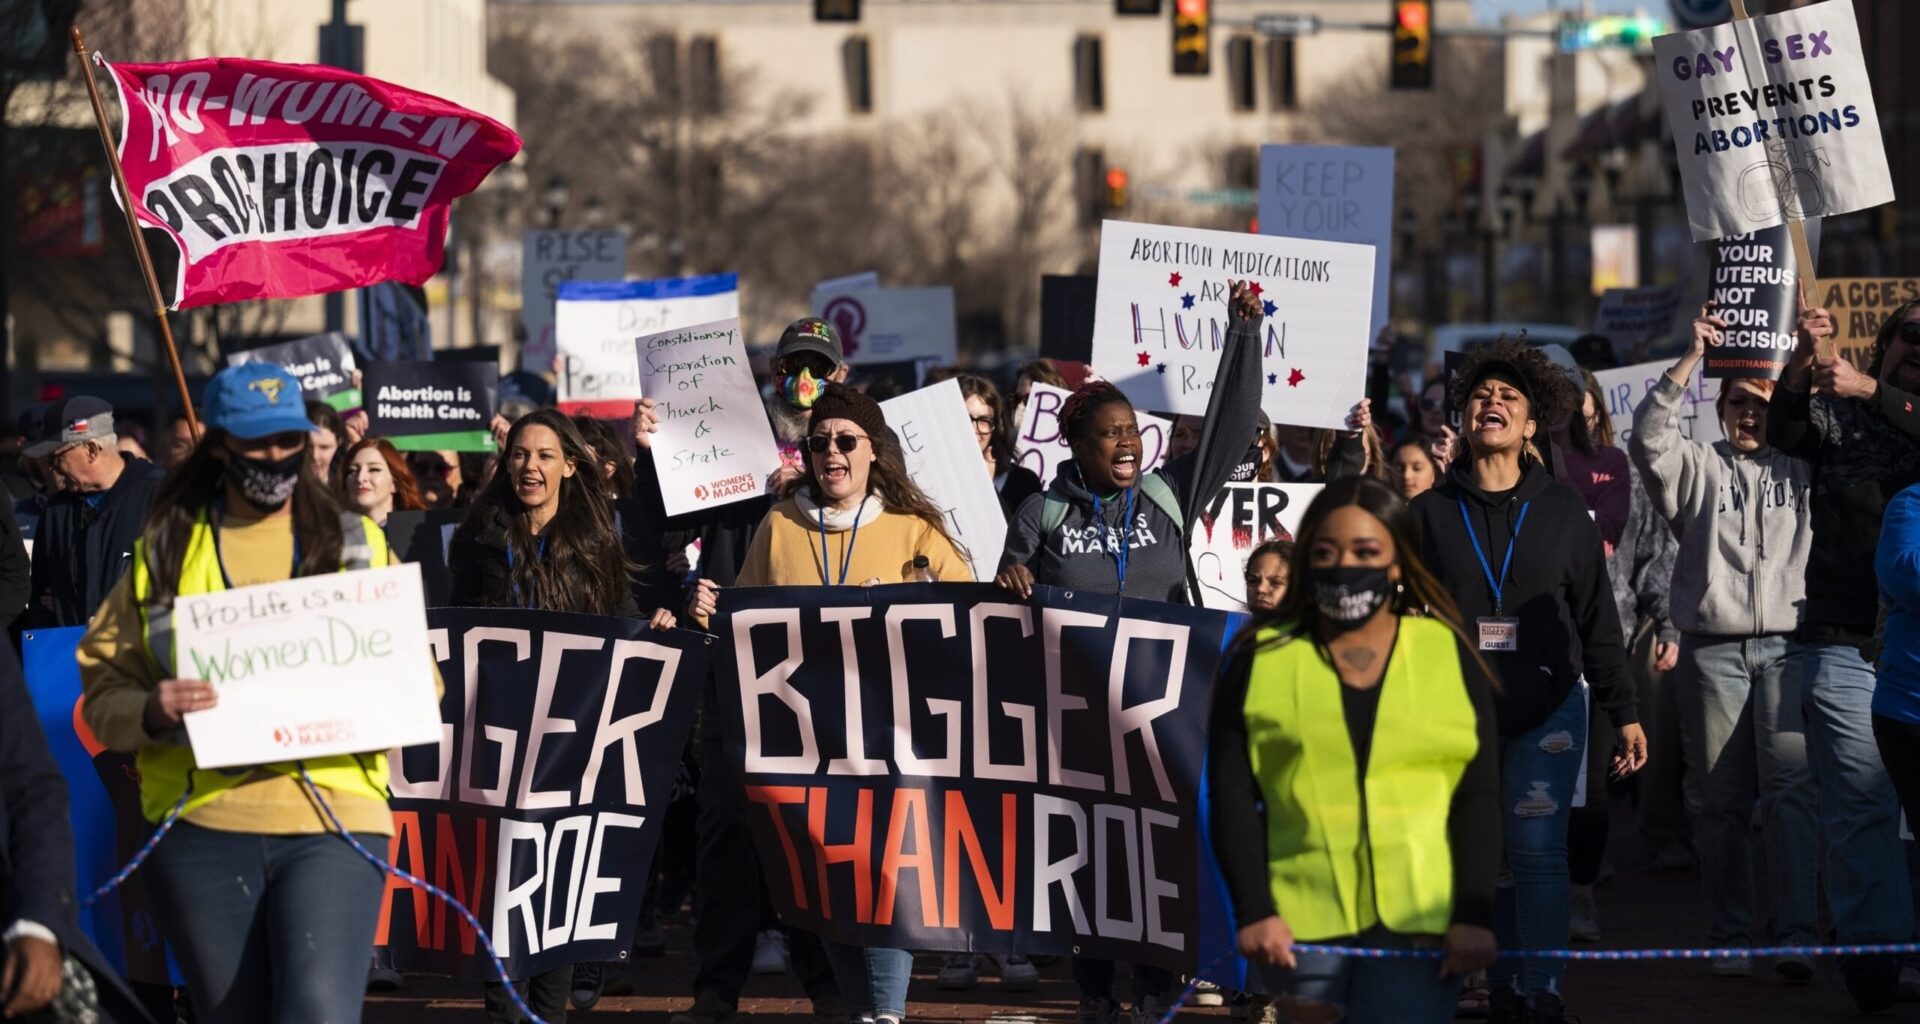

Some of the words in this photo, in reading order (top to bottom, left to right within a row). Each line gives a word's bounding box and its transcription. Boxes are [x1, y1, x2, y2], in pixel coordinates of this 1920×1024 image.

[1673, 46, 1735, 81] GAY
[1764, 30, 1832, 64] SEX
[1692, 75, 1836, 120] PREVENTS
[136, 71, 482, 162] RO-WOMEN
[1694, 105, 1861, 155] ABORTIONS
[1276, 161, 1364, 196] KEEP
[1280, 199, 1361, 233] YOUR
[536, 230, 618, 262] RISE
[1718, 245, 1773, 263] YOUR
[1131, 238, 1212, 267] ABORTION
[1223, 249, 1330, 283] MEDICATIONS
[1715, 267, 1795, 285] UTERUS
[1200, 279, 1228, 307] AR
[1713, 287, 1755, 305] NOT
[1823, 281, 1919, 307] ACCES
[1131, 302, 1286, 359] HUMN
[1712, 309, 1769, 327] YOUR
[316, 356, 331, 372] is
[644, 349, 736, 384] Seperation
[303, 373, 343, 391] Care.
[377, 386, 454, 402] Abortion
[457, 387, 471, 402] is
[678, 373, 704, 391] of
[377, 403, 434, 419] Health
[436, 403, 481, 420] Care.
[651, 397, 724, 424] Church
[694, 420, 712, 439] &
[671, 445, 736, 471] State
[710, 474, 753, 489] WOMEN'S
[1230, 471, 1251, 481] DIES
[713, 481, 756, 499] MARCH
[356, 579, 400, 604] Lie
[190, 637, 326, 685] Women
[318, 614, 395, 666] Die
[1485, 641, 1510, 649] GUEST
[731, 602, 1191, 803] BIGGER
[387, 626, 683, 809] GGER
[745, 784, 1017, 931] THAN
[1032, 793, 1185, 951] ROE
[372, 810, 487, 955] AN
[493, 812, 646, 958] ROE
